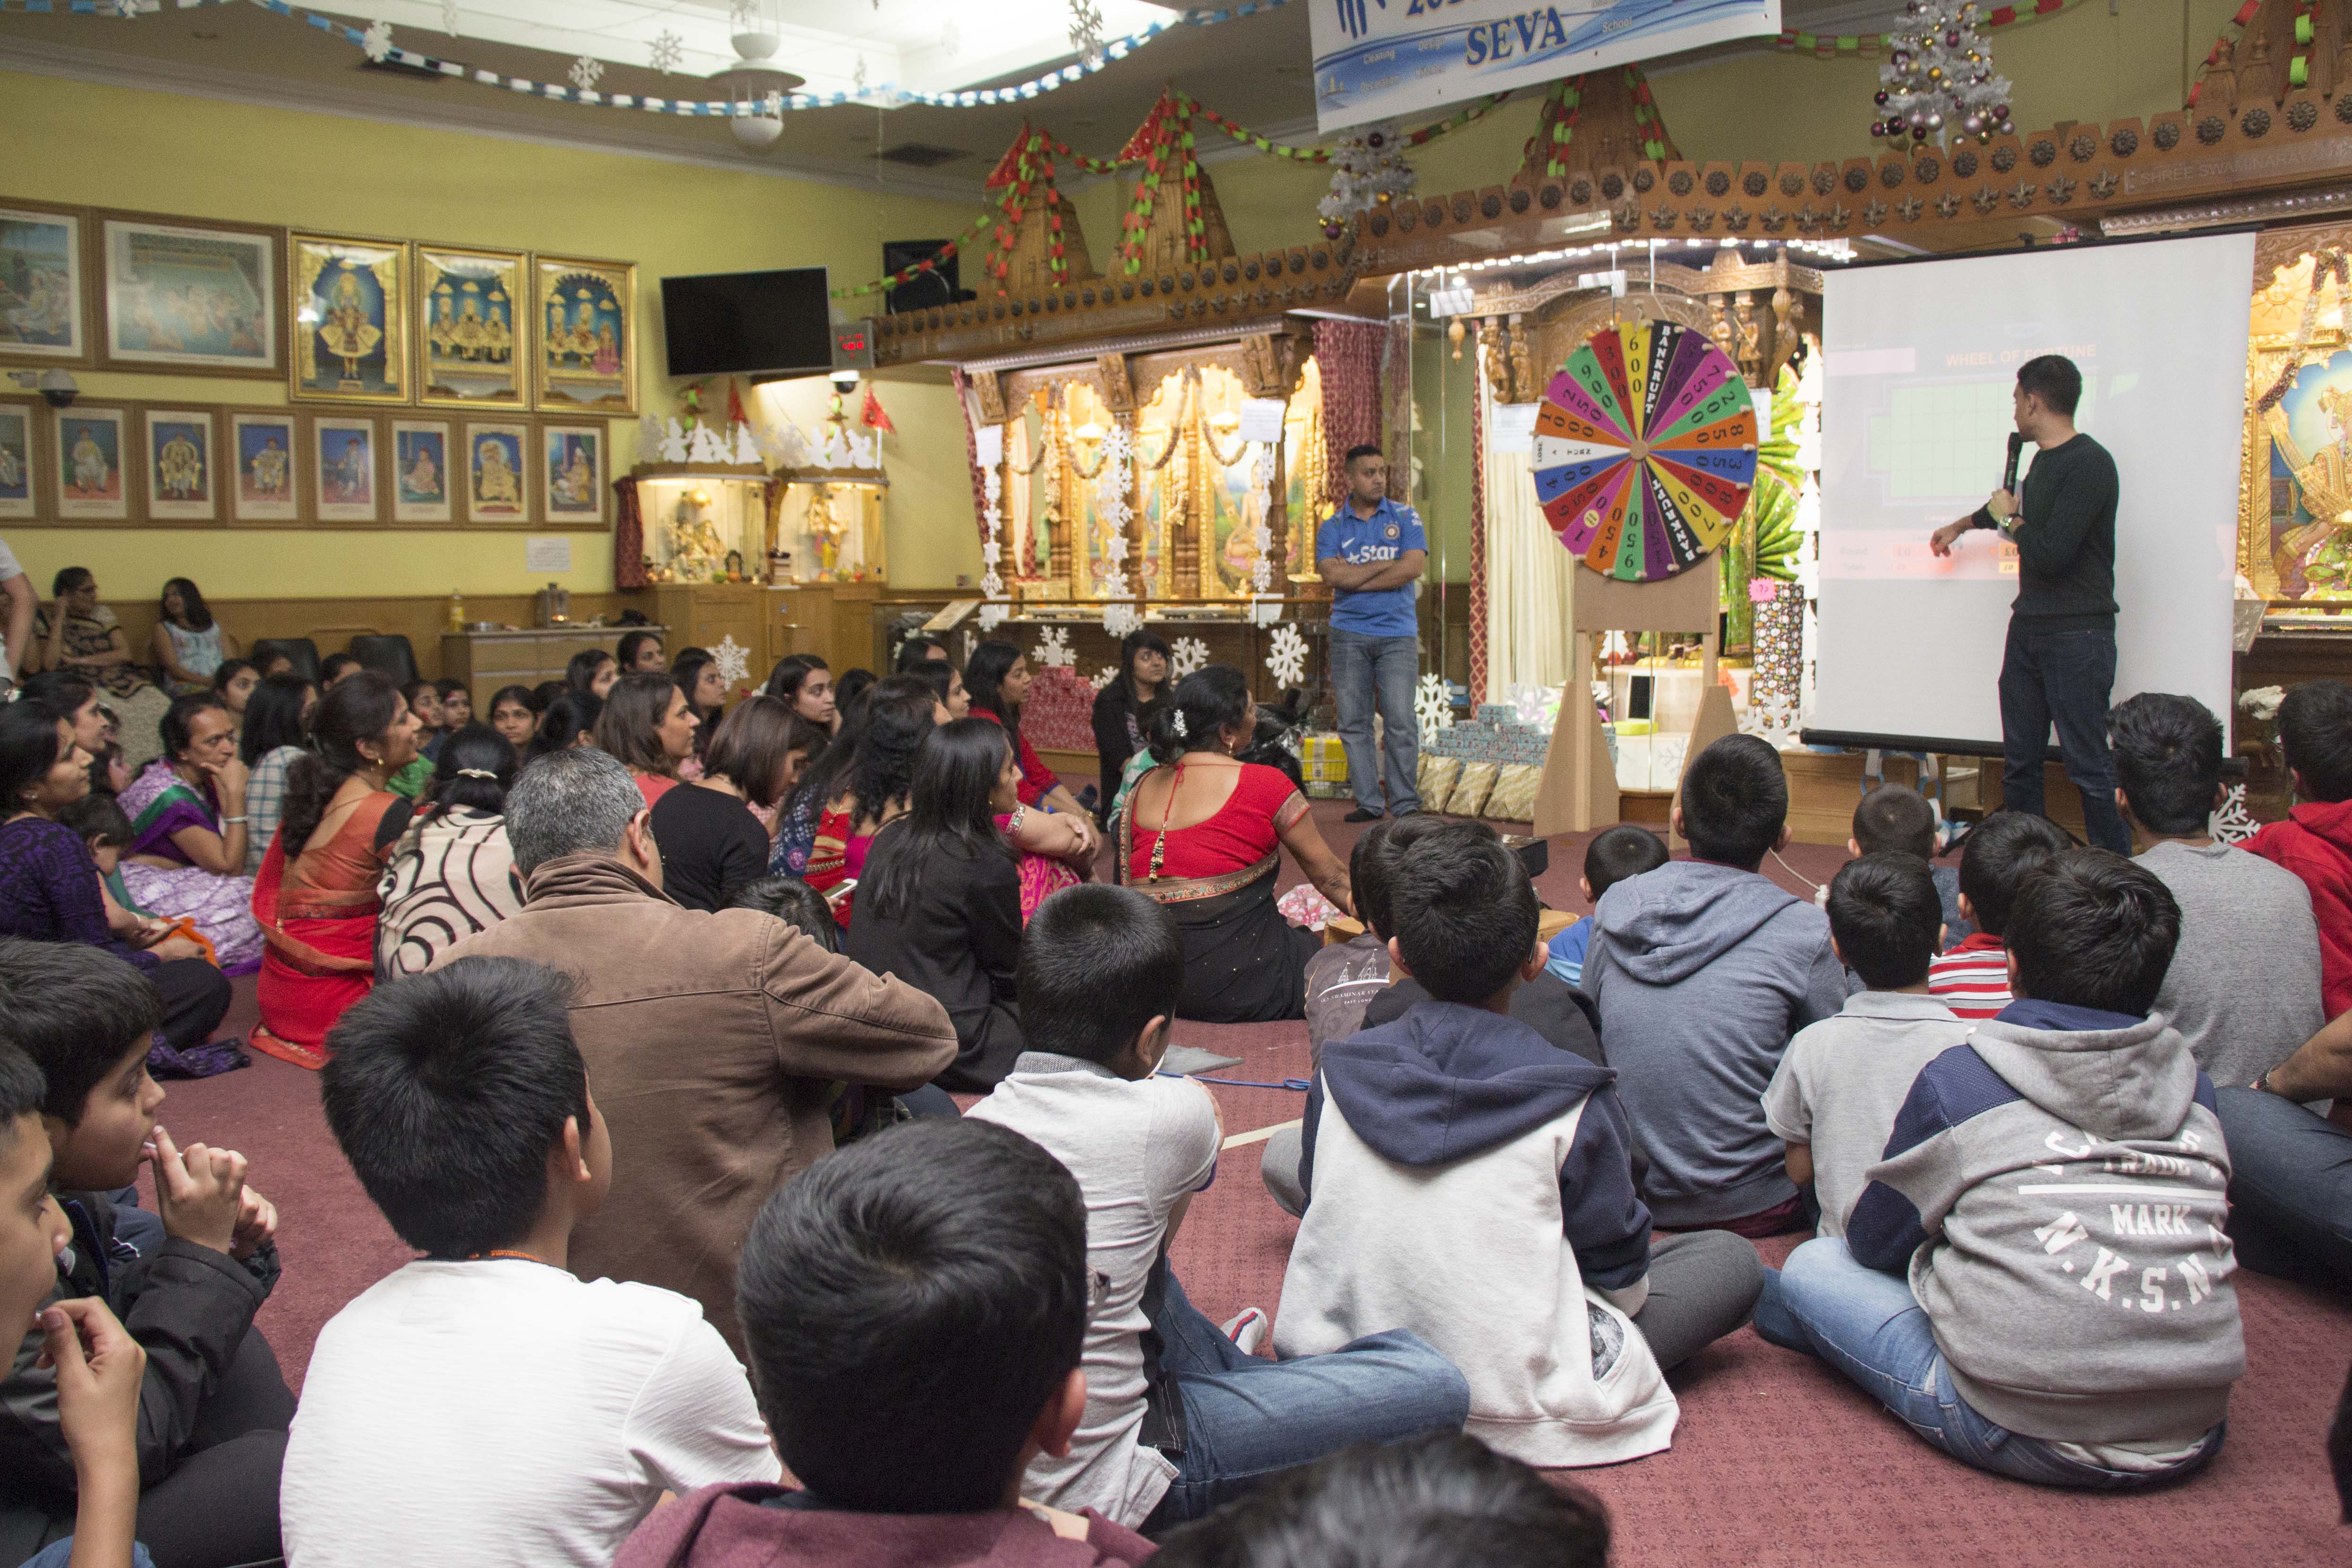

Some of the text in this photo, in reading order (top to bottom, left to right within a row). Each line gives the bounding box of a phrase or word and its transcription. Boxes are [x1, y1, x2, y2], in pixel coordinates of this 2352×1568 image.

[1466, 7, 1567, 66] SEVA
[1602, 16, 1633, 33] School
[1363, 49, 1396, 64] Cleaning
[2140, 165, 2194, 185] SHREE
[1605, 346, 1627, 398] 300
[1629, 336, 1642, 393] 600
[1644, 326, 1670, 414] BANKRUPT
[1946, 352, 1997, 367] WHEEL
[2000, 350, 2020, 363] OF
[1581, 365, 1613, 409] 900
[1681, 366, 1721, 405] 750
[1562, 388, 1602, 421] 250
[1691, 391, 1735, 424] 200
[1539, 412, 1594, 438] 1000
[1696, 423, 1745, 443] 850
[1546, 465, 1592, 489] 400
[1695, 455, 1742, 470] 350
[1558, 482, 1599, 517] 650
[1689, 474, 1733, 505] 800
[1651, 479, 1696, 561] BANKRUPT
[1678, 490, 1716, 532] 700
[1599, 507, 1623, 559] 450
[1625, 511, 1638, 568] 950
[1360, 545, 1399, 563] star
[1331, 990, 1379, 1000] SWAMINARAYA
[2109, 1204, 2193, 1235] MARK
